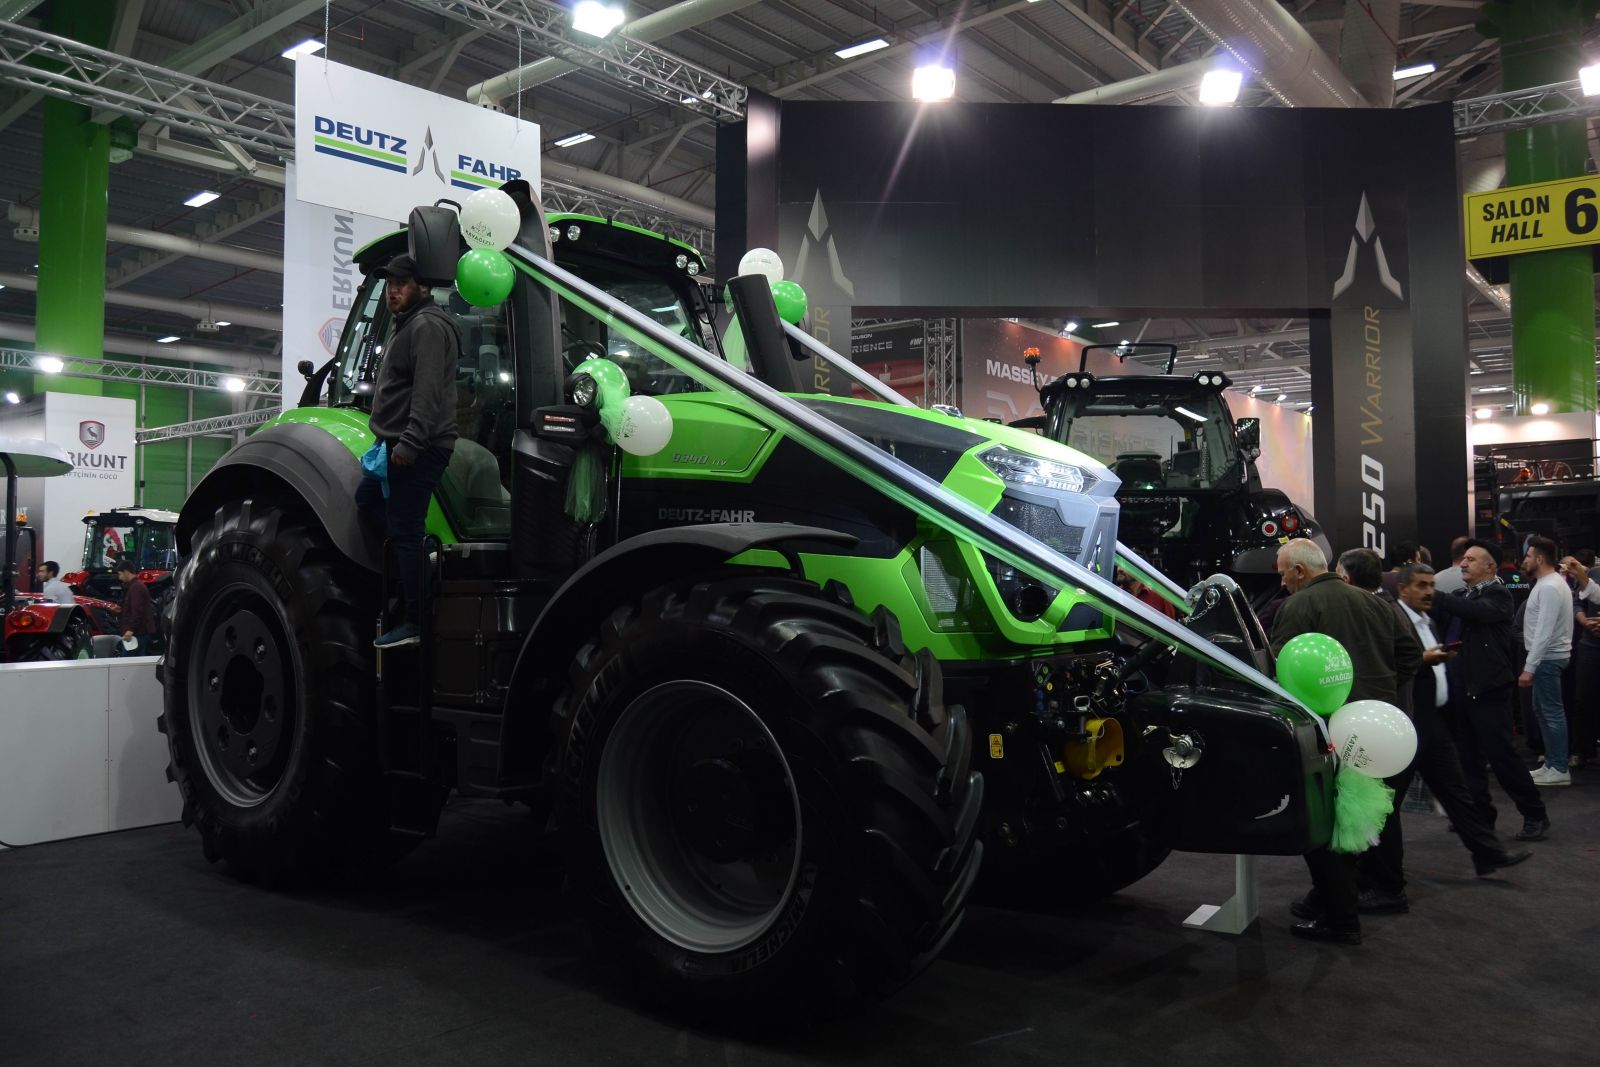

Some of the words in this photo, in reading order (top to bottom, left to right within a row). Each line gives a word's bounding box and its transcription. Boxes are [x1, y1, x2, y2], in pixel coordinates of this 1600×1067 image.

[315, 115, 407, 155] DEUTZ
[458, 154, 522, 182] FAHR
[1482, 195, 1550, 221] SALON
[1564, 187, 1599, 235] 6
[1490, 220, 1543, 243] HALL
[658, 507, 756, 523] DEUTZ-FAHR
[1361, 454, 1385, 560] 250
